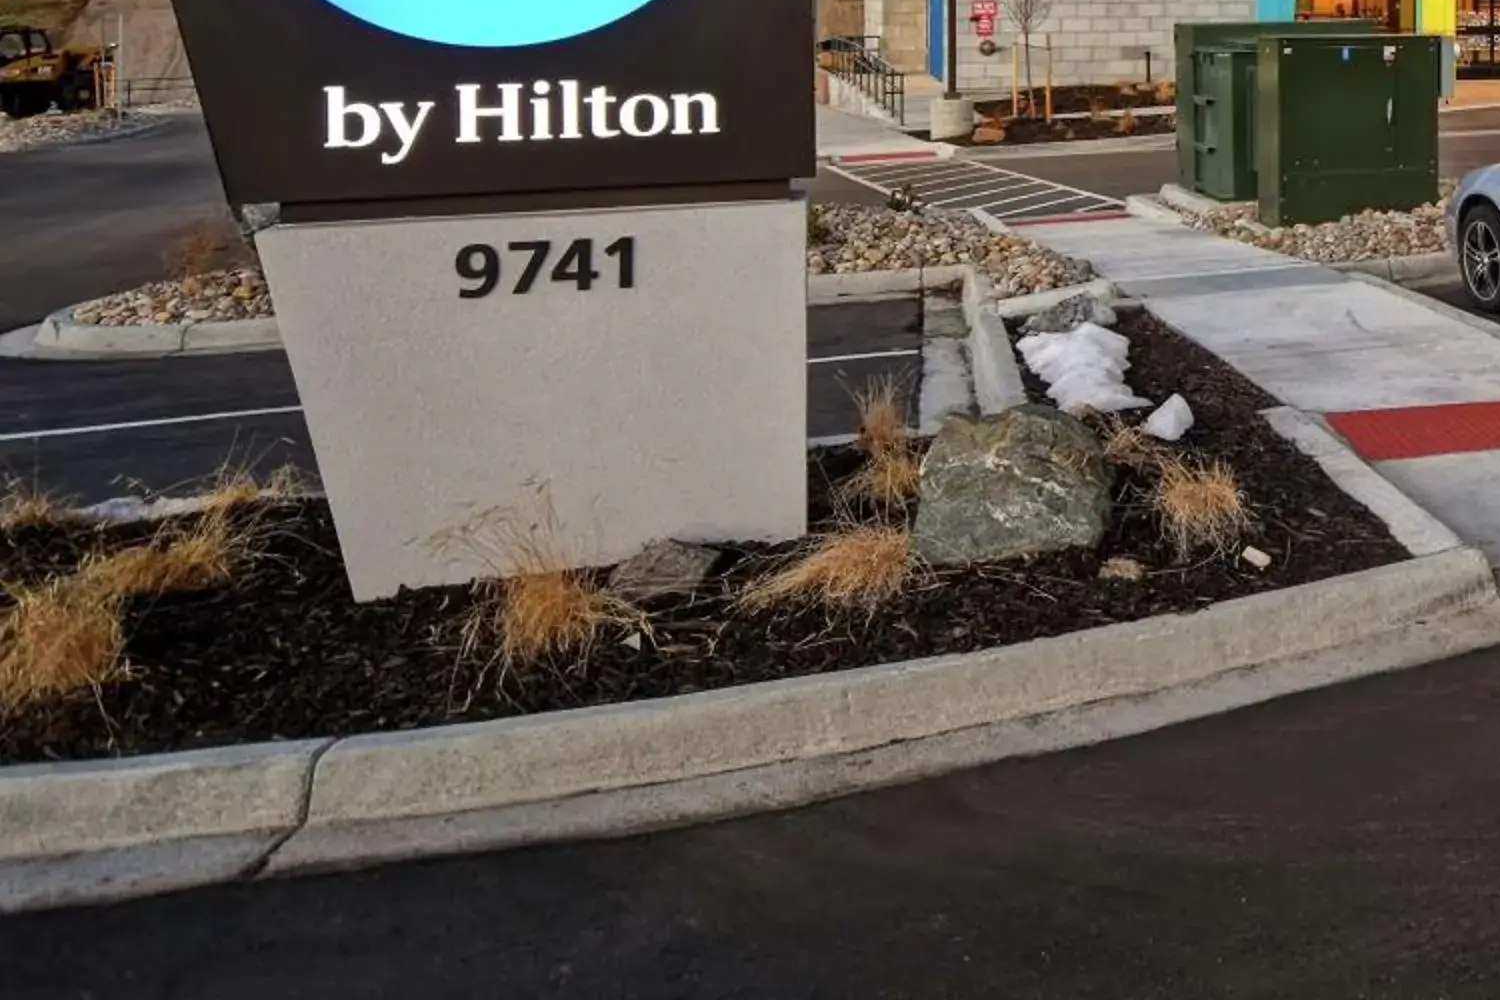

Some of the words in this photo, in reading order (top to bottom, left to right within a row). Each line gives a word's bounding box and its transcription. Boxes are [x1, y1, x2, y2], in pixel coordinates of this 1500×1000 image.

[323, 85, 436, 165] by
[454, 79, 721, 143] Hilton
[454, 236, 635, 299] 9741
